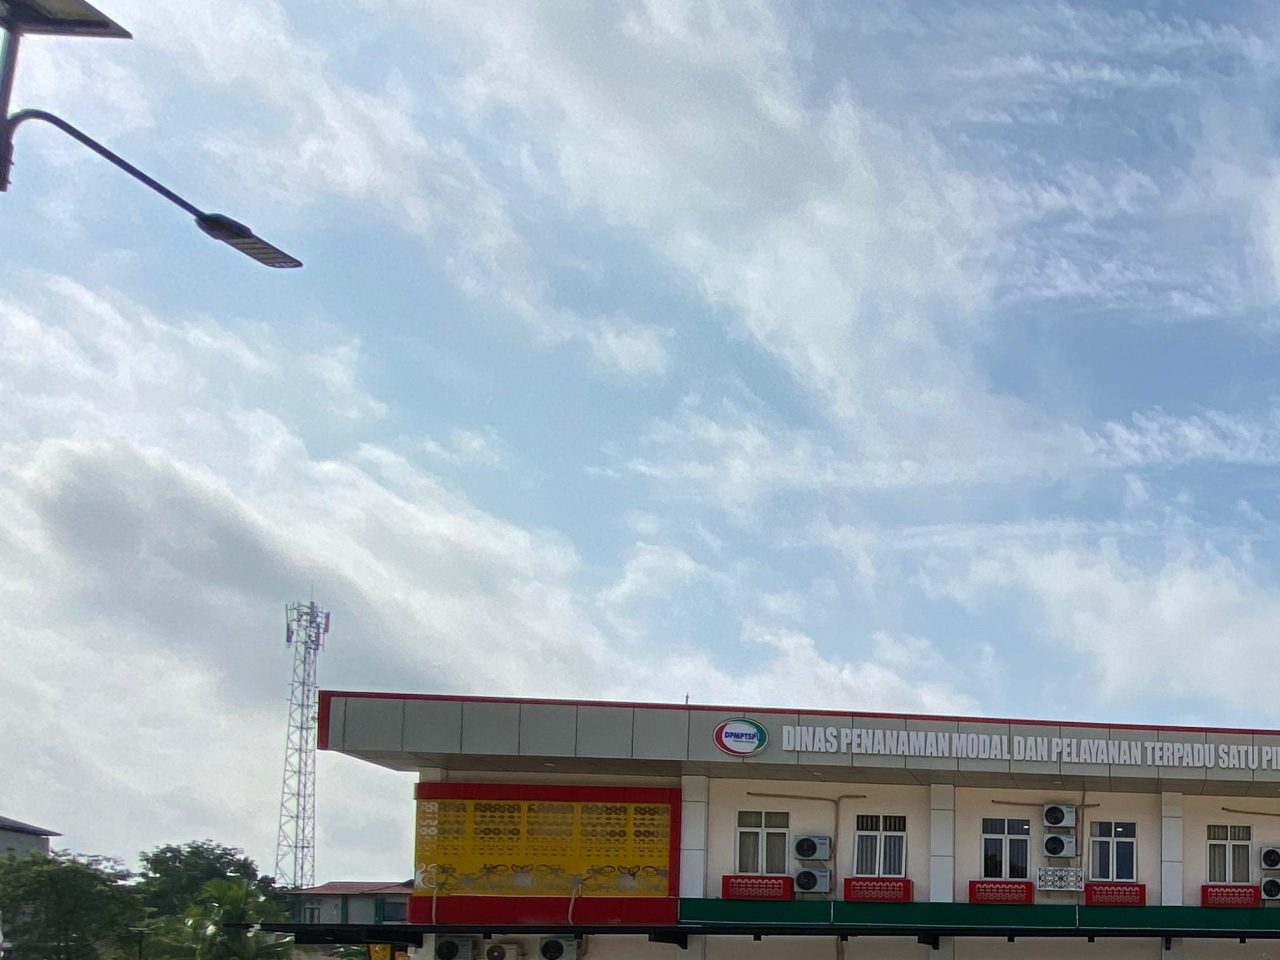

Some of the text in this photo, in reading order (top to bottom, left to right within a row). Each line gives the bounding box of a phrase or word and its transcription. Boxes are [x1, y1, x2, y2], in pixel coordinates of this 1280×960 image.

[782, 725, 838, 753] DINAS
[840, 728, 950, 758] PENANAMAN
[951, 733, 1011, 760] MODAL
[1013, 735, 1048, 761] DAN
[1051, 737, 1142, 765] PELAYANAN
[1144, 741, 1215, 768] TERPADU
[1218, 744, 1258, 769] SATU
